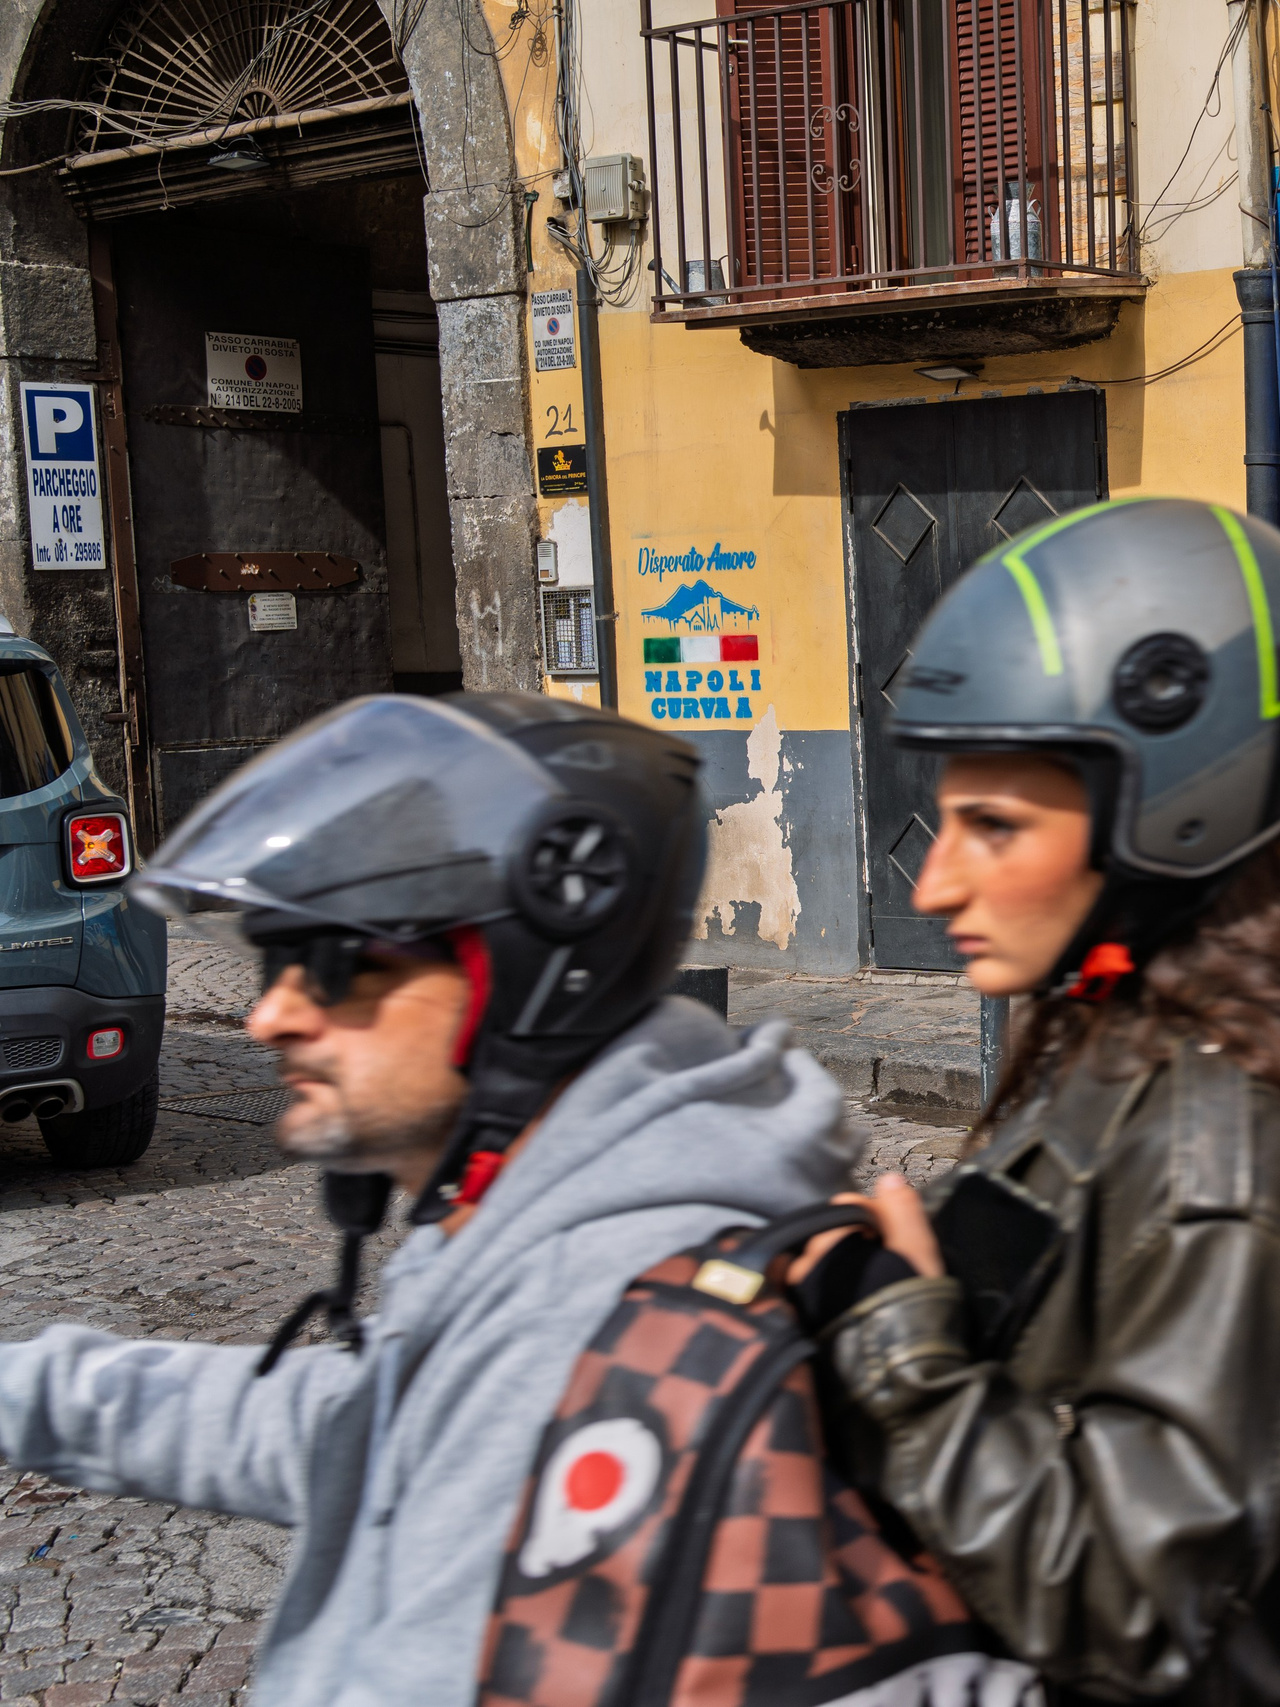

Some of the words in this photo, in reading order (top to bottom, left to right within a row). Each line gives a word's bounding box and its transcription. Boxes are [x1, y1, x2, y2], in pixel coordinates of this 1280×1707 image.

[546, 292, 572, 304] CARRABILE
[534, 306, 550, 317] DIVIETO
[551, 305, 556, 315] DI
[557, 304, 571, 315] SOSTA
[208, 334, 241, 345] PASSO
[243, 337, 298, 350] CARRABILE
[558, 337, 573, 346] NAPOLI
[212, 343, 252, 354] DIVIETO
[253, 347, 263, 355] DI
[264, 348, 295, 358] SOSTA
[537, 346, 572, 356] AUTORIZZAZIONE
[548, 355, 556, 367] DEL
[210, 377, 253, 387] COMUNE
[265, 382, 299, 390] NAPOLI
[215, 385, 296, 397] AUTORIZZAZIONE
[225, 394, 241, 407] 214
[243, 395, 261, 408] DEL
[262, 396, 301, 410] 22-8-2005
[34, 395, 84, 454] P
[545, 403, 578, 439] 21
[32, 468, 97, 498] PARCHEGGIO
[52, 505, 60, 533] A
[61, 505, 83, 533] ORE
[55, 542, 68, 562] 081
[74, 542, 102, 562] 295886
[638, 546, 705, 582] Disperato
[706, 542, 757, 572] Amore
[644, 669, 762, 693] NAPOLI
[651, 697, 731, 719] CURVA
[735, 697, 753, 719] A
[0, 936, 74, 952] LIMITED
